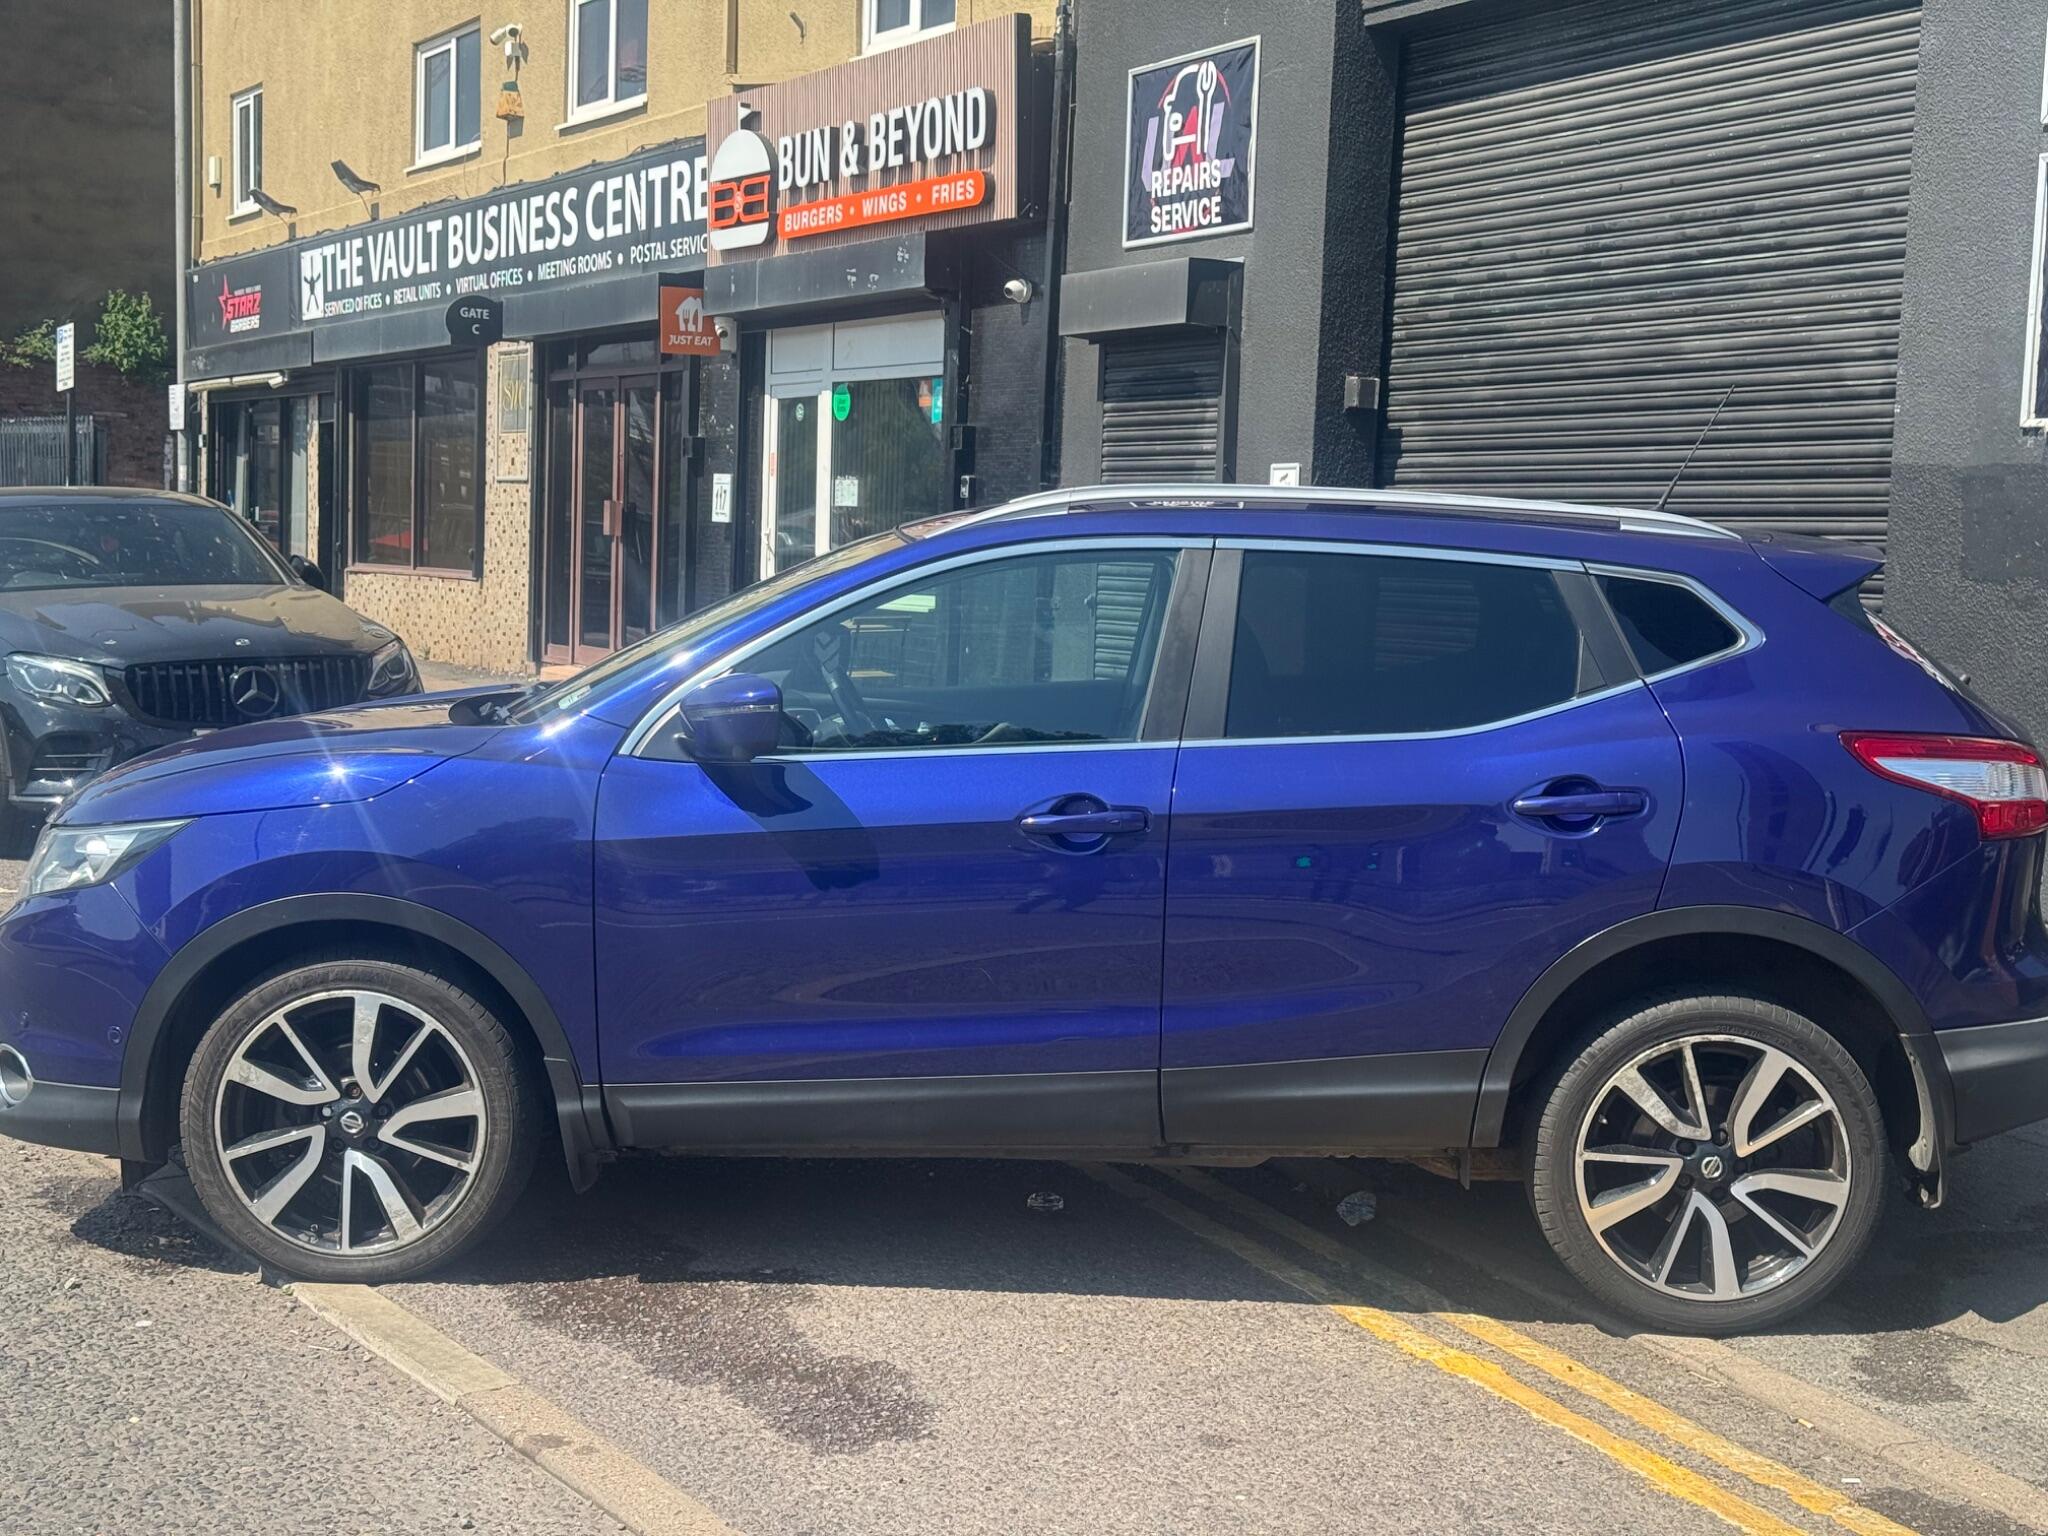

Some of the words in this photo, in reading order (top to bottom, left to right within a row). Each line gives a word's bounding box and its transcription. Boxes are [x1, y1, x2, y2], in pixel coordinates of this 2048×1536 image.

[779, 125, 831, 191] BUN
[840, 120, 860, 177] &
[869, 86, 987, 172] BEYOND
[1151, 158, 1222, 199] REPAIRS
[322, 237, 364, 293] THE
[367, 219, 443, 283] VAULT
[448, 186, 579, 269] BUSINESS
[585, 155, 708, 241] CENTRE
[784, 203, 843, 232] BURGERS
[862, 190, 907, 218] WINGS
[931, 178, 975, 205] FRIES
[1150, 195, 1222, 234] SERVICE
[324, 298, 354, 318] SERVICED
[393, 285, 418, 305] RETAIL
[418, 282, 442, 301] UNITS
[455, 273, 489, 294] VIRTUAL
[490, 267, 523, 289] OFFICES
[537, 256, 577, 281] MEETING
[578, 250, 613, 275] ROOMS
[630, 240, 669, 265] POSTAL
[225, 291, 262, 321] STARZ
[459, 306, 490, 320] GATE
[471, 323, 480, 335] C
[668, 334, 693, 346] JUST
[694, 335, 714, 347] EAT
